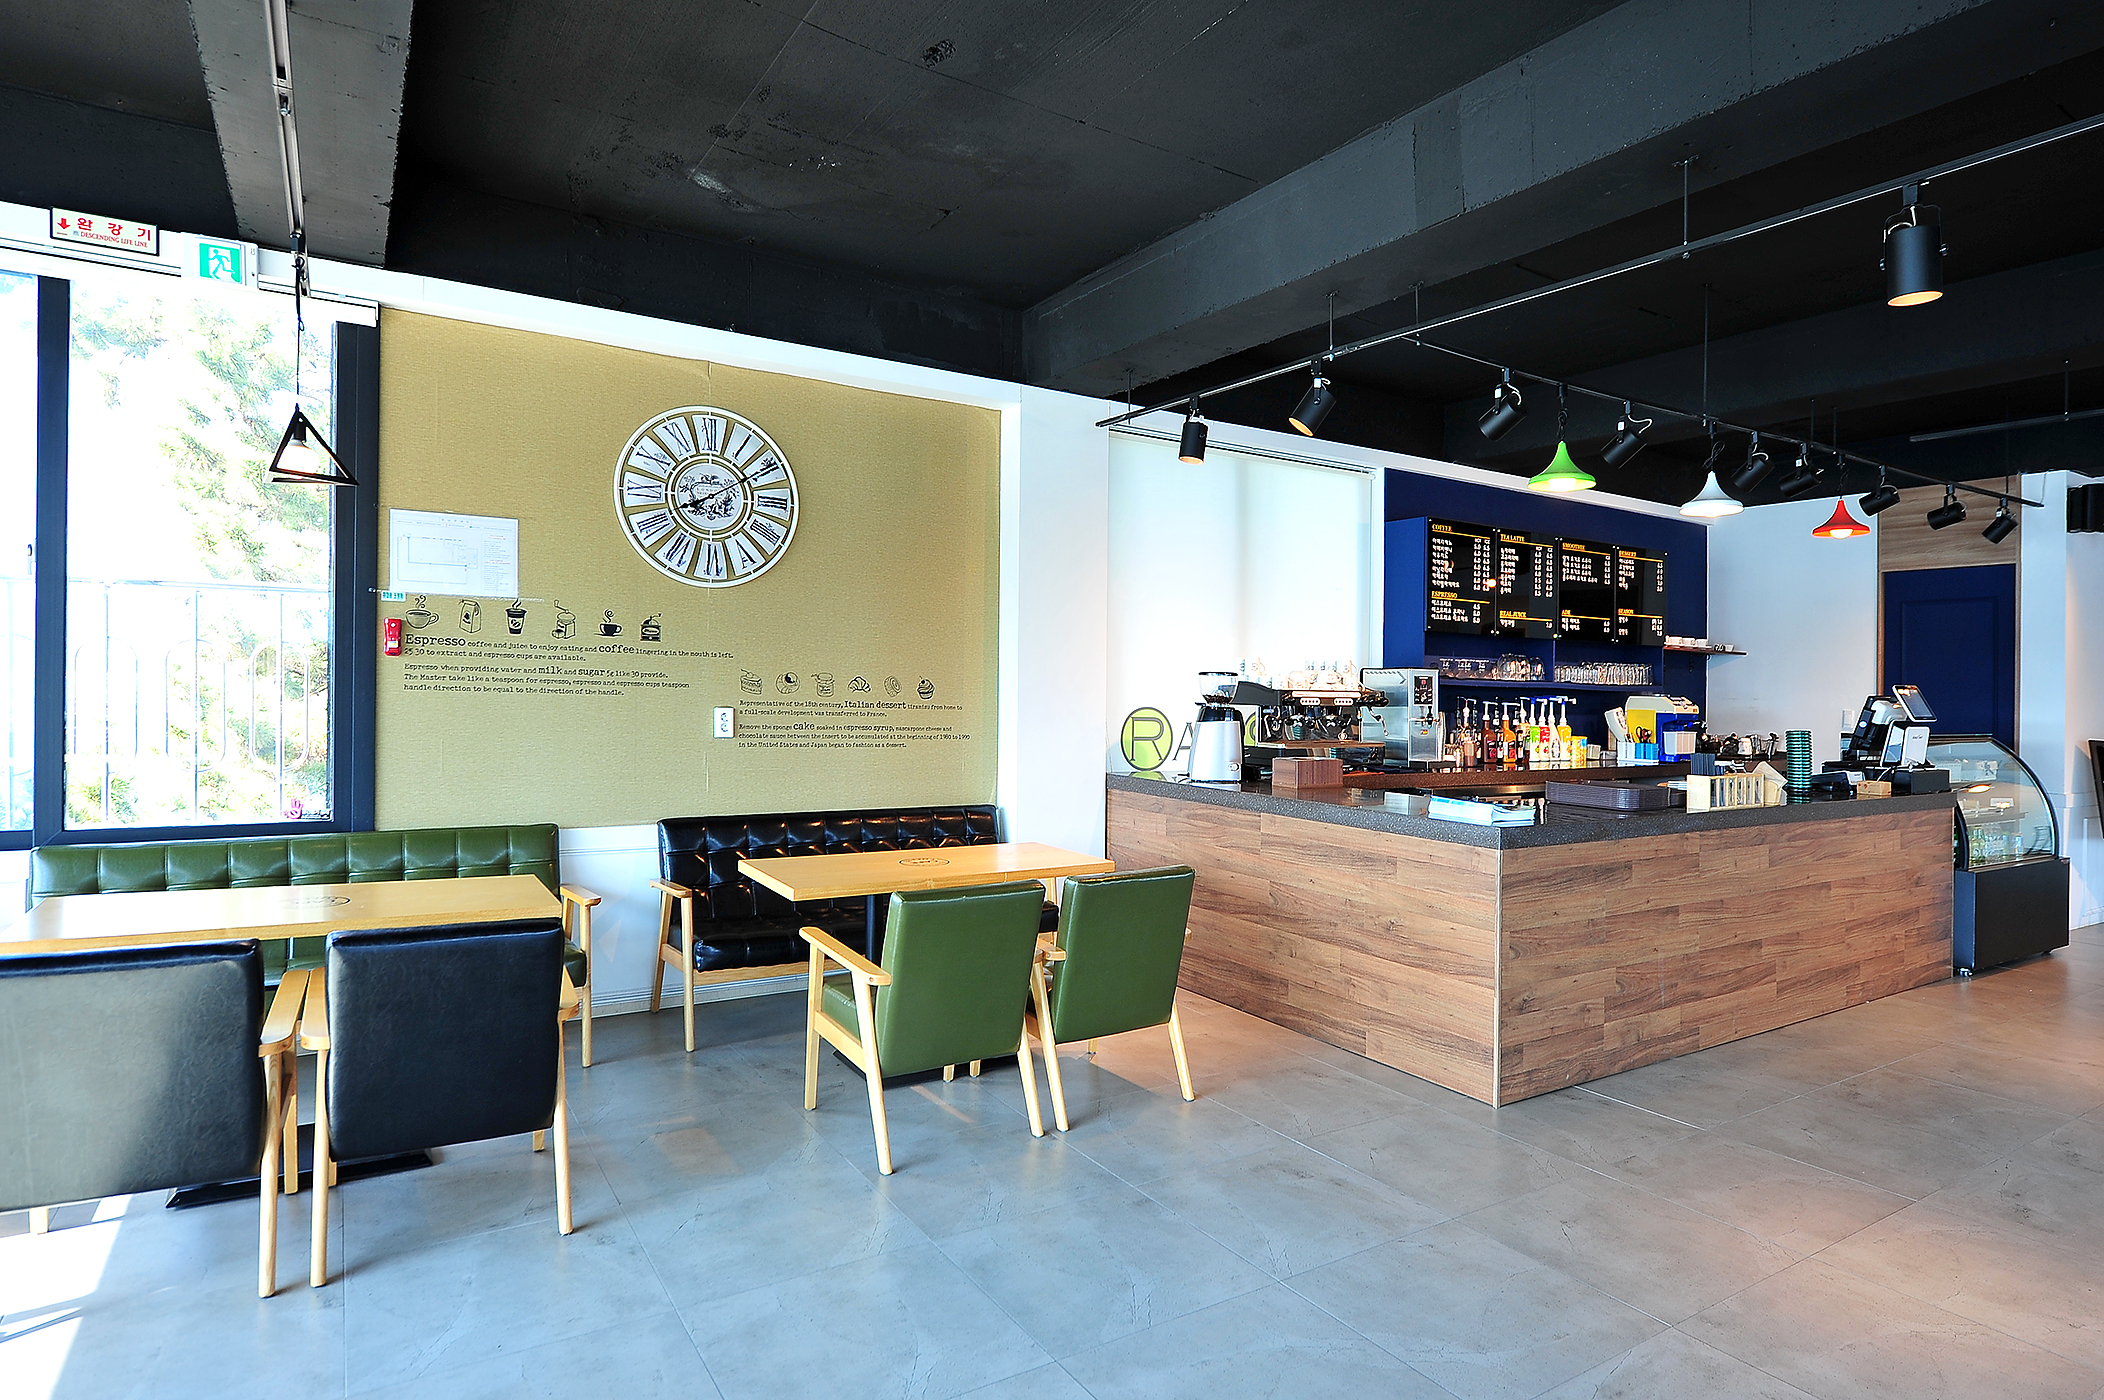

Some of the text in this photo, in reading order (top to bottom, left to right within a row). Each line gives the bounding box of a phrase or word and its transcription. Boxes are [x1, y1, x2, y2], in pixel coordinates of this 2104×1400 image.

[81, 231, 120, 243] DESCENDING
[121, 238, 133, 246] LIFE
[134, 240, 148, 248] LINE
[405, 634, 466, 648] Espresso
[508, 642, 528, 650] juice
[538, 644, 559, 652] enjoy
[560, 645, 584, 653] eating
[598, 644, 635, 654] coffee
[636, 648, 668, 656] lingering
[436, 649, 467, 657] extract
[405, 663, 438, 671] Espresso
[461, 665, 499, 673] providing
[539, 666, 563, 674] milk
[578, 669, 605, 677] sugar
[844, 701, 874, 709] Italian
[876, 701, 907, 709] dessert
[793, 722, 815, 730] cake
